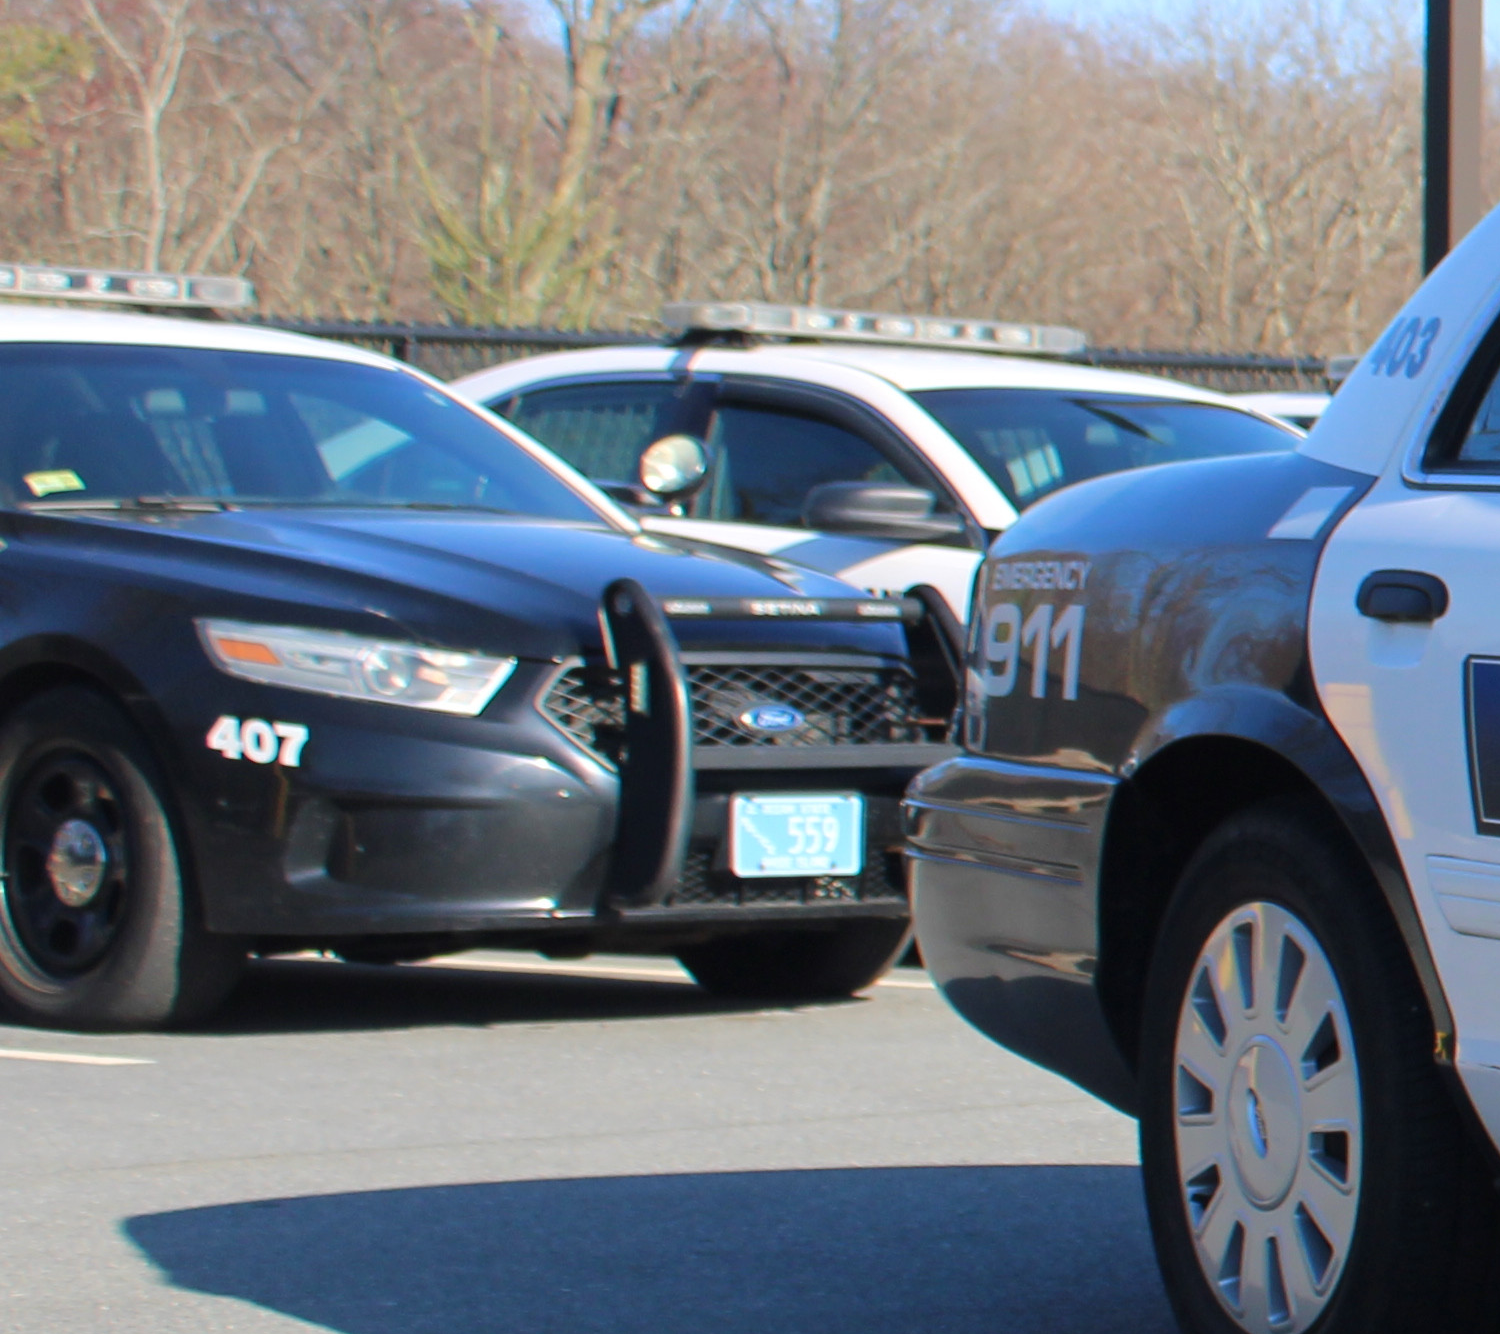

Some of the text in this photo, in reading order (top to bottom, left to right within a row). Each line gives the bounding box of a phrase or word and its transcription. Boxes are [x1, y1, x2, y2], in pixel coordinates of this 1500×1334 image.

[992, 560, 1093, 591] EMERGENCY
[982, 602, 1087, 702] 911
[206, 715, 310, 767] 407
[788, 816, 840, 855] 559
